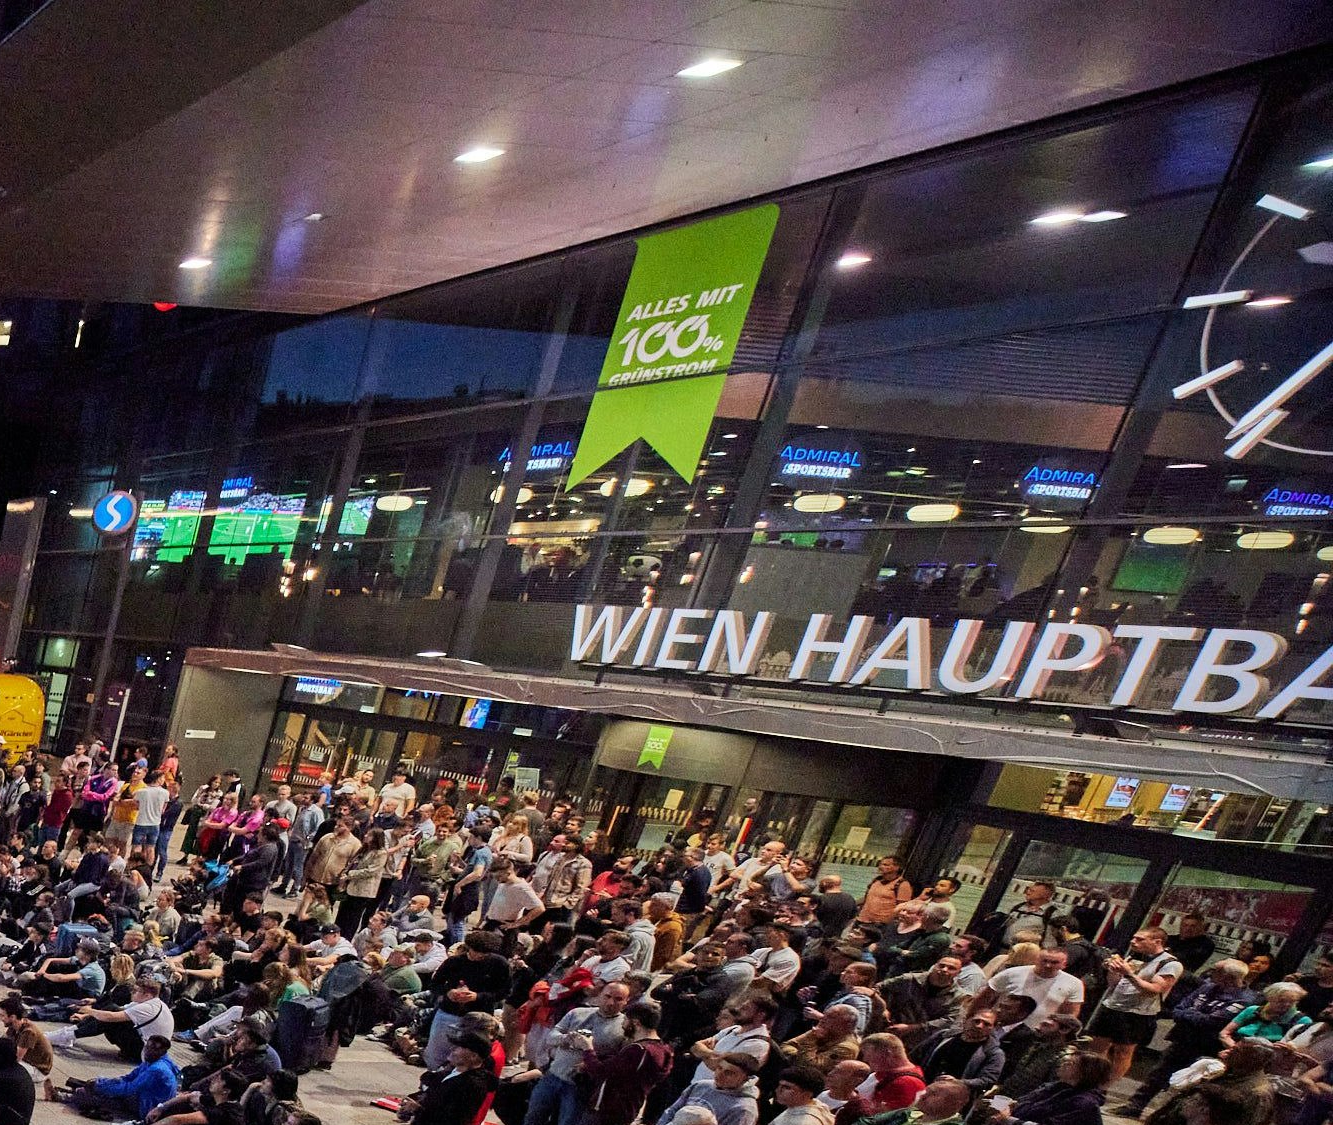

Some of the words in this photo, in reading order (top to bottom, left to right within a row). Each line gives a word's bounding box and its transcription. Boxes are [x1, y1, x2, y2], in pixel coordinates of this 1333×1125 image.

[626, 294, 692, 323] ALLES
[695, 283, 744, 309] MIT
[618, 314, 724, 367] 100%
[608, 358, 719, 388] GRÜNSTROM
[499, 441, 573, 461] AIRAL
[780, 445, 861, 467] ADMIRAL
[221, 476, 253, 489] DMIRAL
[1024, 466, 1101, 488] ADMIRA
[1263, 488, 1333, 510] ADMIRA
[570, 605, 774, 675] WIEN
